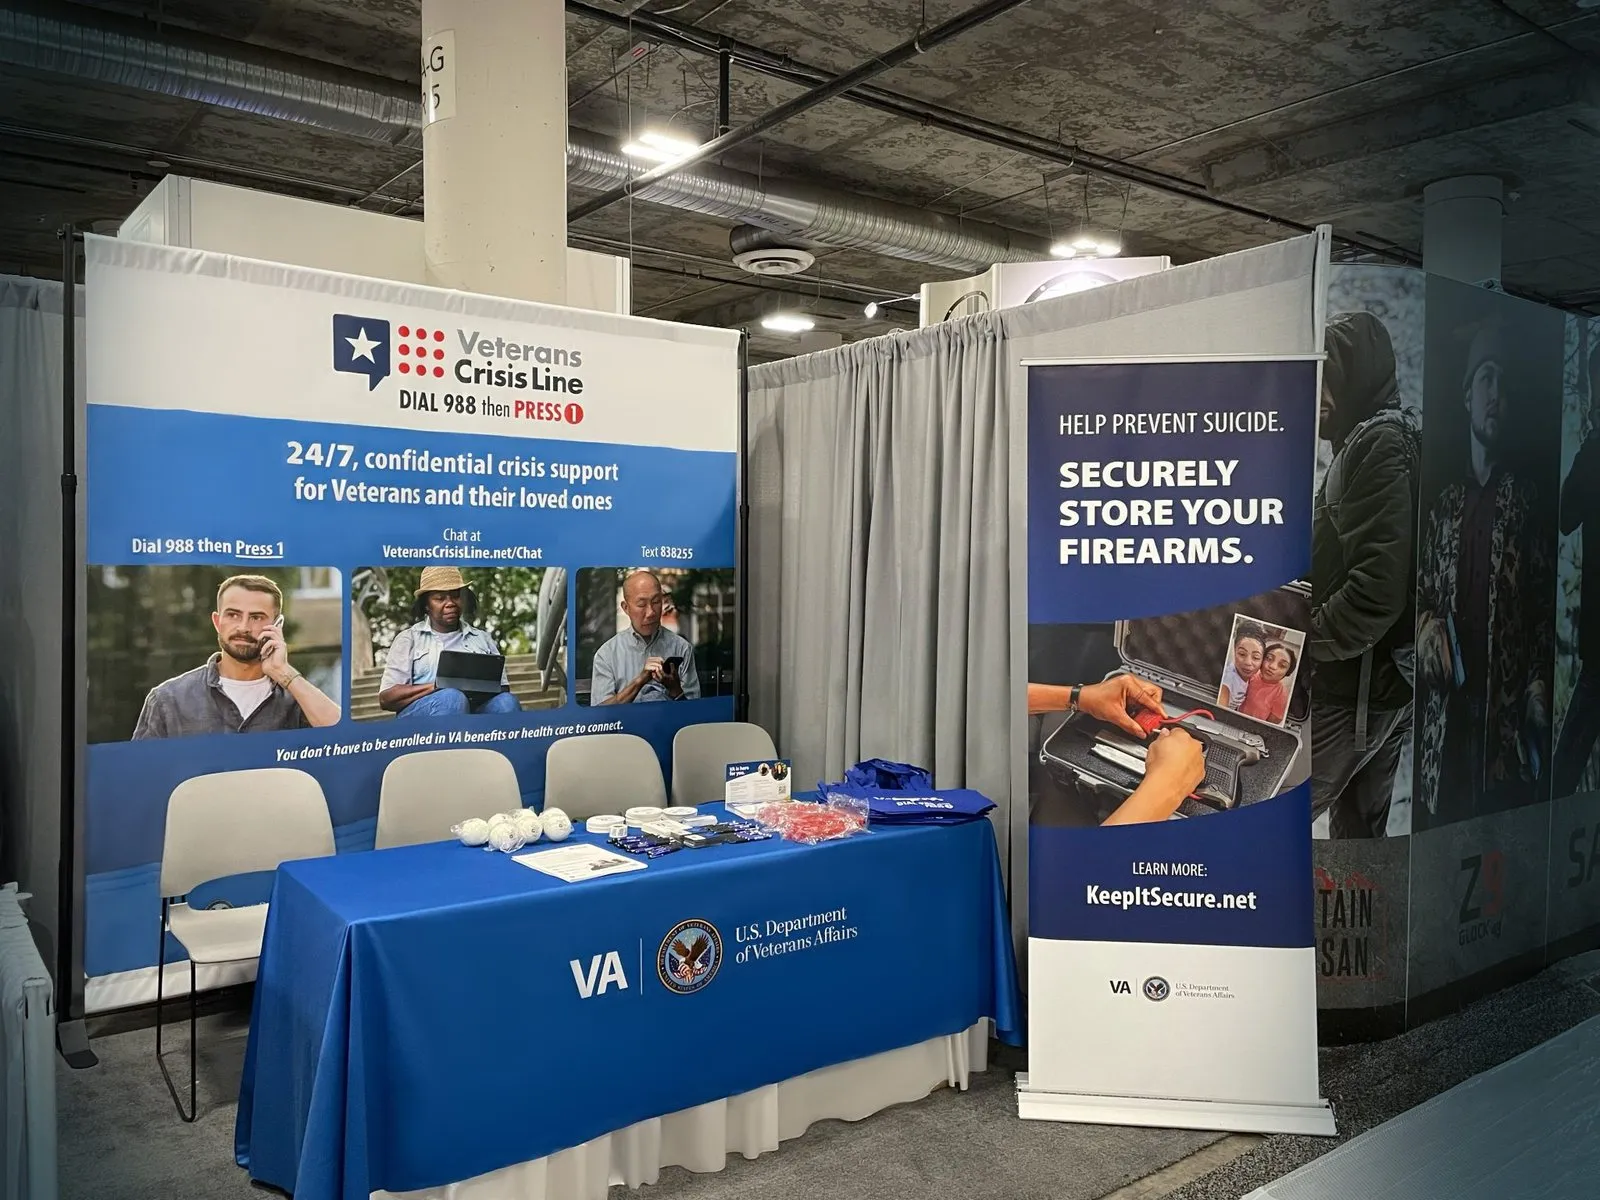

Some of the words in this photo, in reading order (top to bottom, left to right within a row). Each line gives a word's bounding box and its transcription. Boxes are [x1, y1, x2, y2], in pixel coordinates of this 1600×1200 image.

[457, 329, 582, 368] Veterans
[454, 359, 528, 389] Crisis
[532, 365, 584, 395] Line
[400, 389, 438, 412] DIAL
[443, 394, 477, 415] 988
[482, 396, 510, 418] then
[514, 400, 562, 422] PRESS
[1059, 414, 1107, 435] HELP
[1112, 412, 1198, 435] PREVENT
[1203, 411, 1285, 433] SUICIDE.
[286, 440, 359, 471] 24/7,
[364, 448, 493, 475] confidential
[498, 456, 546, 478] crisis
[550, 462, 619, 485] support
[1059, 459, 1239, 488] SECURELY
[294, 476, 327, 501] for
[331, 478, 420, 504] Veterans
[424, 484, 464, 506] and
[469, 486, 516, 508] their
[520, 487, 568, 510] loved
[572, 493, 613, 511] ones
[1059, 499, 1174, 527] STORE
[1180, 498, 1284, 525] YOUR
[132, 538, 162, 554] Dial
[165, 538, 194, 554] 988
[198, 537, 232, 554] then
[235, 540, 273, 556] Press
[276, 541, 284, 556] 1
[443, 528, 468, 542] Chat
[470, 530, 481, 542] at
[382, 545, 543, 559] VeteransCrisisLine.net/Chat
[641, 546, 659, 558] Text
[660, 546, 693, 560] 838255
[1059, 537, 1254, 565] FIREARMS.
[276, 749, 298, 762] You
[334, 743, 360, 756] have
[362, 741, 373, 752] to
[375, 738, 388, 751] be
[389, 732, 433, 749] enrolled
[434, 732, 446, 744] in
[448, 732, 462, 744] VA
[464, 729, 507, 743] benefits
[508, 730, 519, 740] or
[521, 726, 553, 739] health
[554, 724, 574, 736] care
[575, 723, 586, 734] to
[587, 720, 624, 733] connect.
[1132, 862, 1169, 876] LEARN
[1171, 863, 1208, 877] MORE:
[1086, 885, 1257, 910] KeepItSecure.net
[1319, 889, 1372, 929] TAIN
[735, 926, 762, 943] U.S.
[766, 906, 847, 938] Department
[735, 948, 751, 964] of
[751, 937, 812, 962] Veterans
[814, 925, 858, 951] Affairs
[1321, 937, 1369, 978] SAN
[570, 950, 629, 999] VA
[1109, 980, 1132, 994] VA
[1189, 983, 1229, 992] Department
[1212, 991, 1235, 999] Affairs
